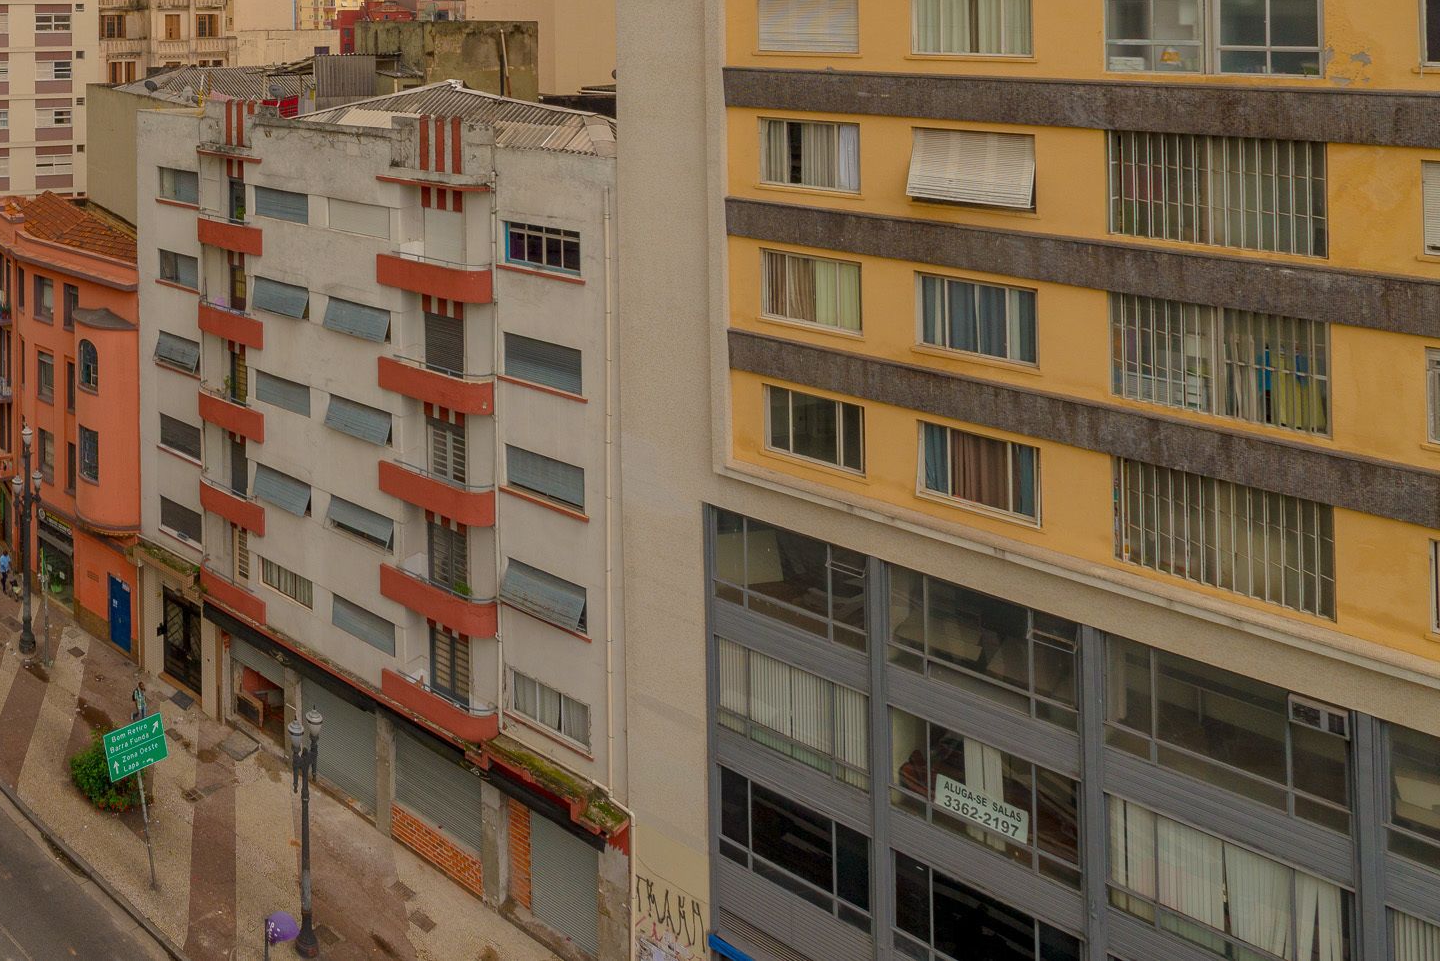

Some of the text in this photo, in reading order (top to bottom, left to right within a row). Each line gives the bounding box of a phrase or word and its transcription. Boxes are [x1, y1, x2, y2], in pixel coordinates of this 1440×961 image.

[109, 733, 150, 754] Barra Funda
[111, 724, 148, 743] Bom Retiro
[122, 743, 159, 763] Zona Oeste
[123, 761, 140, 772] Lapa
[943, 781, 1022, 823] ALUGA-SE SALAS
[943, 795, 1019, 837] 3362-2197
